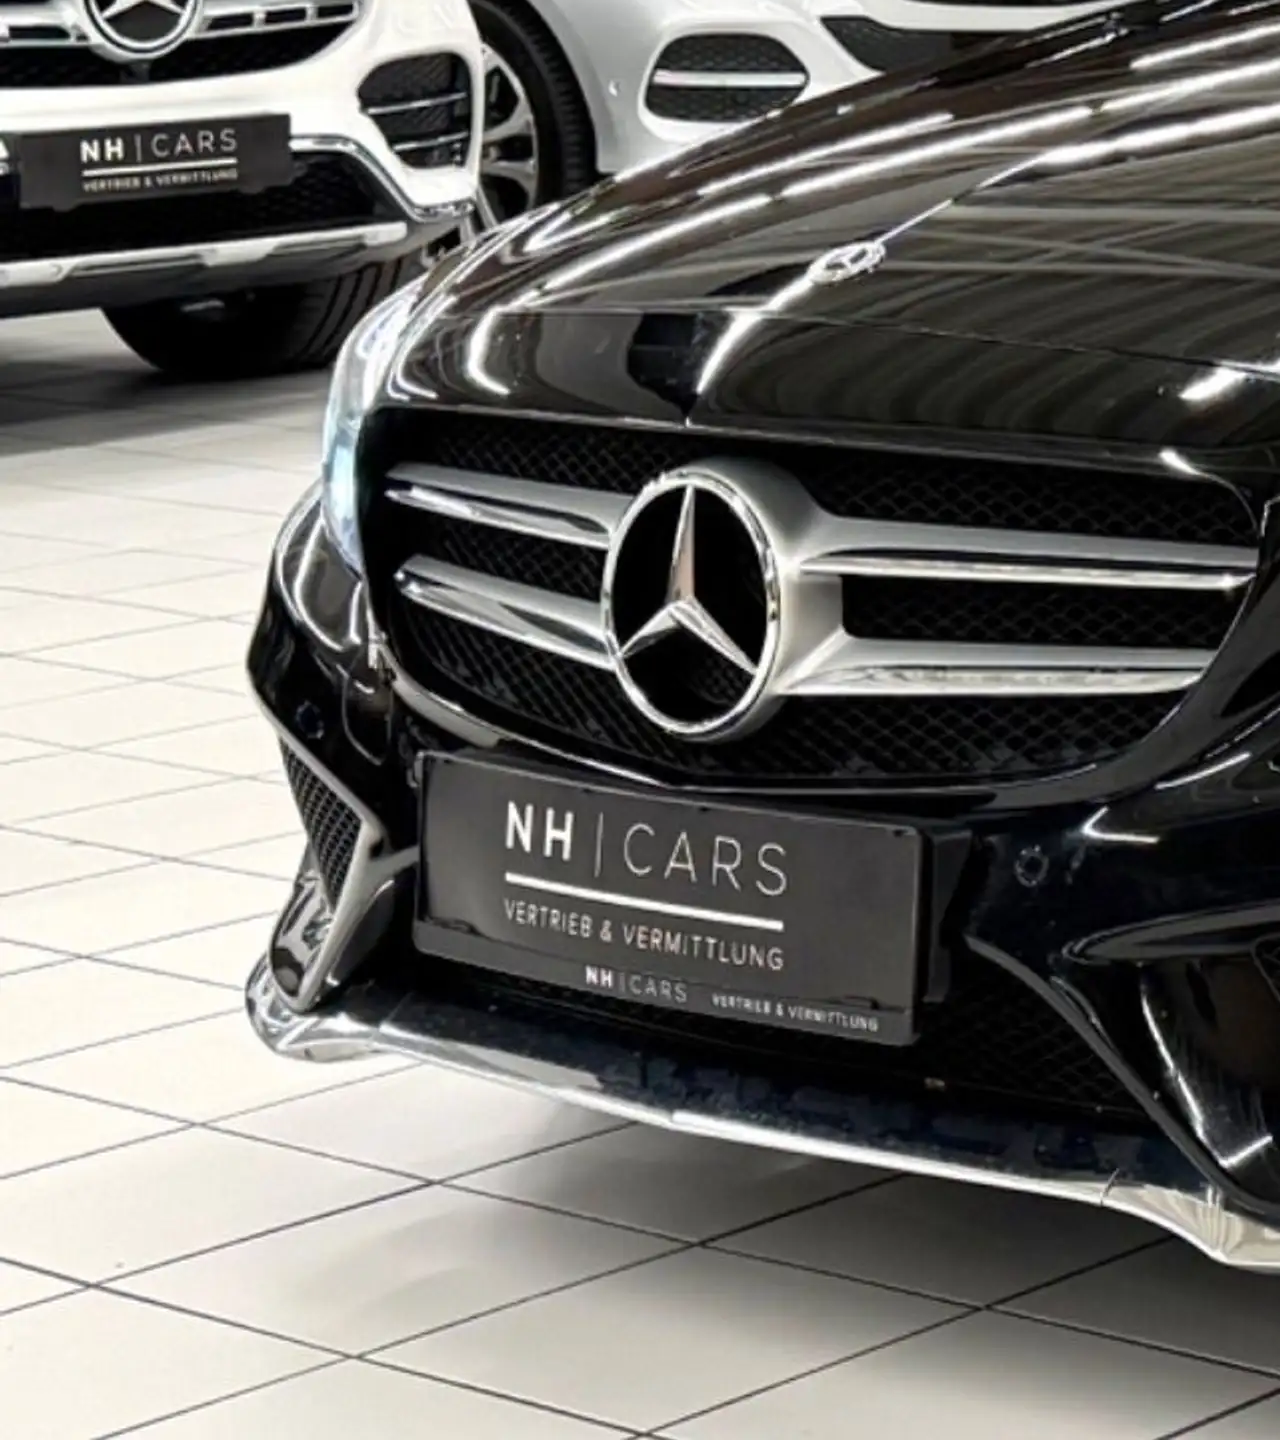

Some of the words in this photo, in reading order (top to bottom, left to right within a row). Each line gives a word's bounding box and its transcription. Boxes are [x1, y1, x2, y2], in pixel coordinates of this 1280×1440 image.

[80, 137, 125, 163] NH
[150, 128, 237, 158] CARS
[505, 801, 574, 861] NH
[622, 822, 788, 897] CARS
[504, 898, 592, 937] VERTRIEB
[600, 920, 613, 944] &
[622, 924, 784, 971] VERMITTLUNG
[585, 965, 613, 989] NH
[628, 972, 687, 1004] CARS
